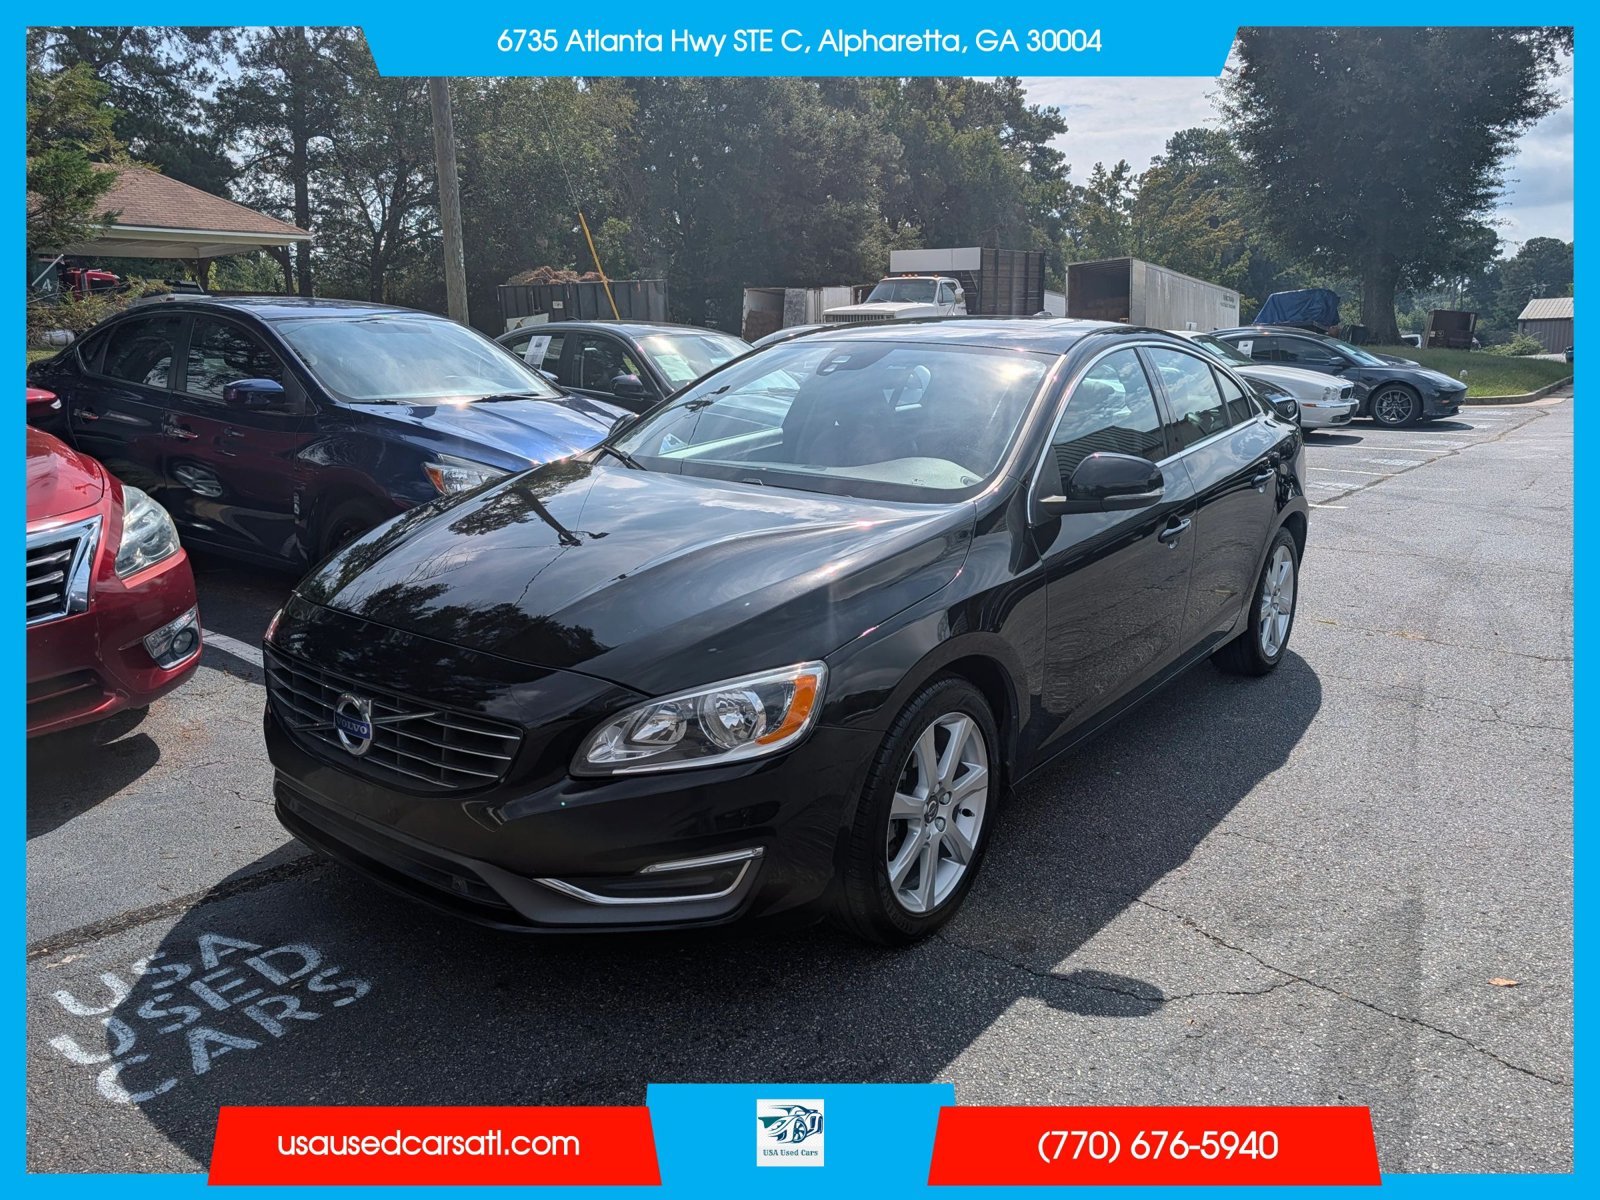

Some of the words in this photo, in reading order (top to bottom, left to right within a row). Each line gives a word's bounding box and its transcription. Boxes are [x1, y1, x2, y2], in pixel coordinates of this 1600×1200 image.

[336, 715, 369, 735] VOLVO
[50, 944, 324, 1065] USED
[53, 932, 262, 1016] USA
[97, 965, 373, 1103] CARS
